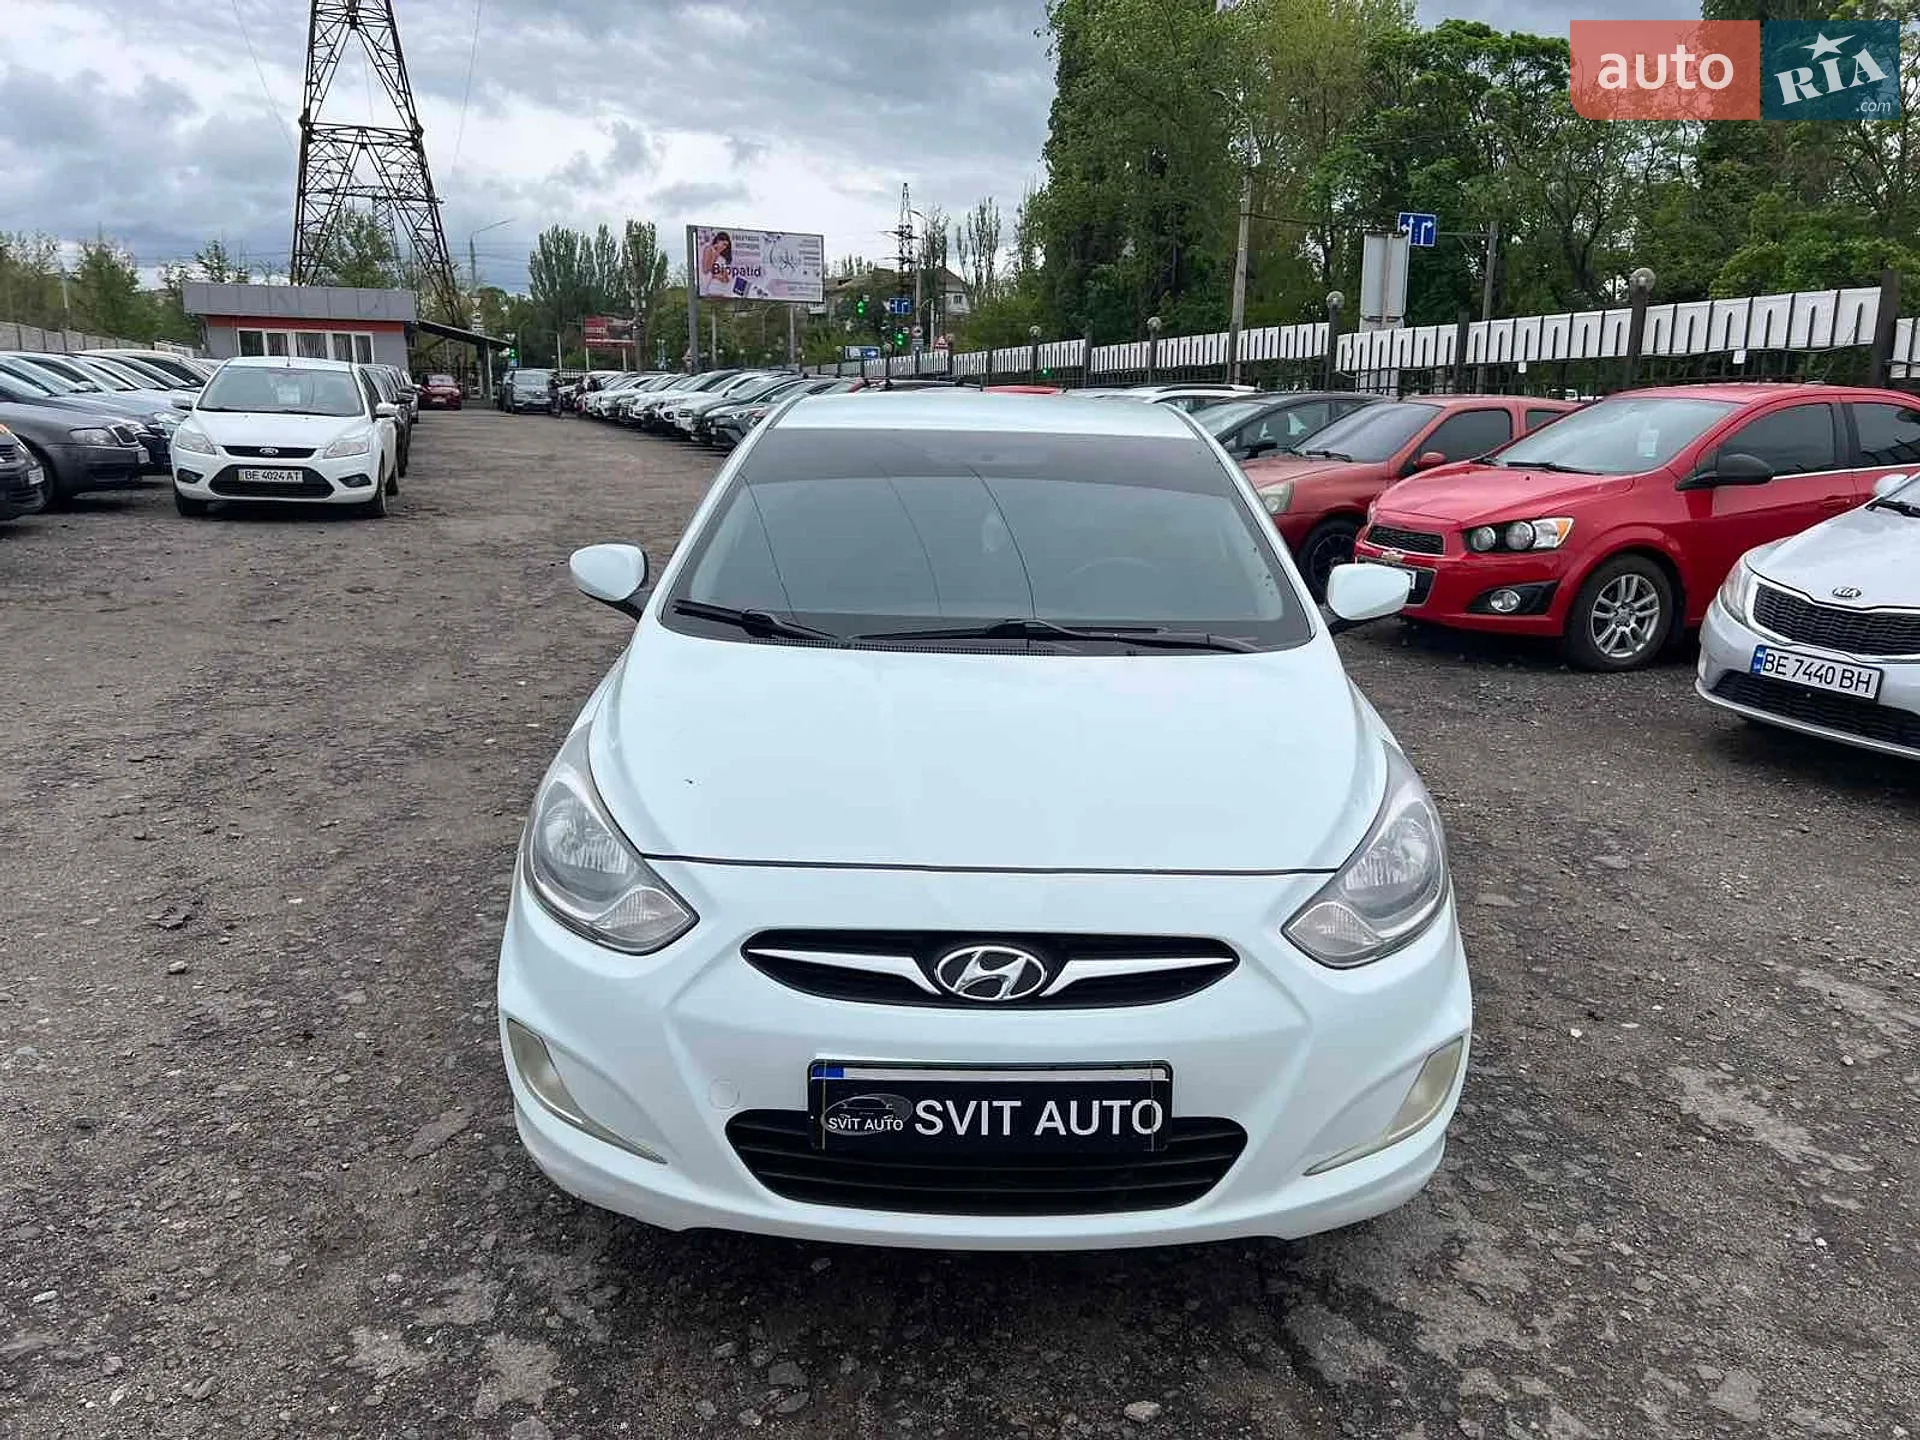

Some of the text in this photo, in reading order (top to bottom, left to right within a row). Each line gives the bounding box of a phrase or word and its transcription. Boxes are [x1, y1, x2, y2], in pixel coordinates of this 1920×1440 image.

[1762, 653, 1873, 693] BE 7440 BH
[828, 1118, 904, 1131] SVIT AUTO
[914, 1099, 1164, 1137] SVIT AUTO
